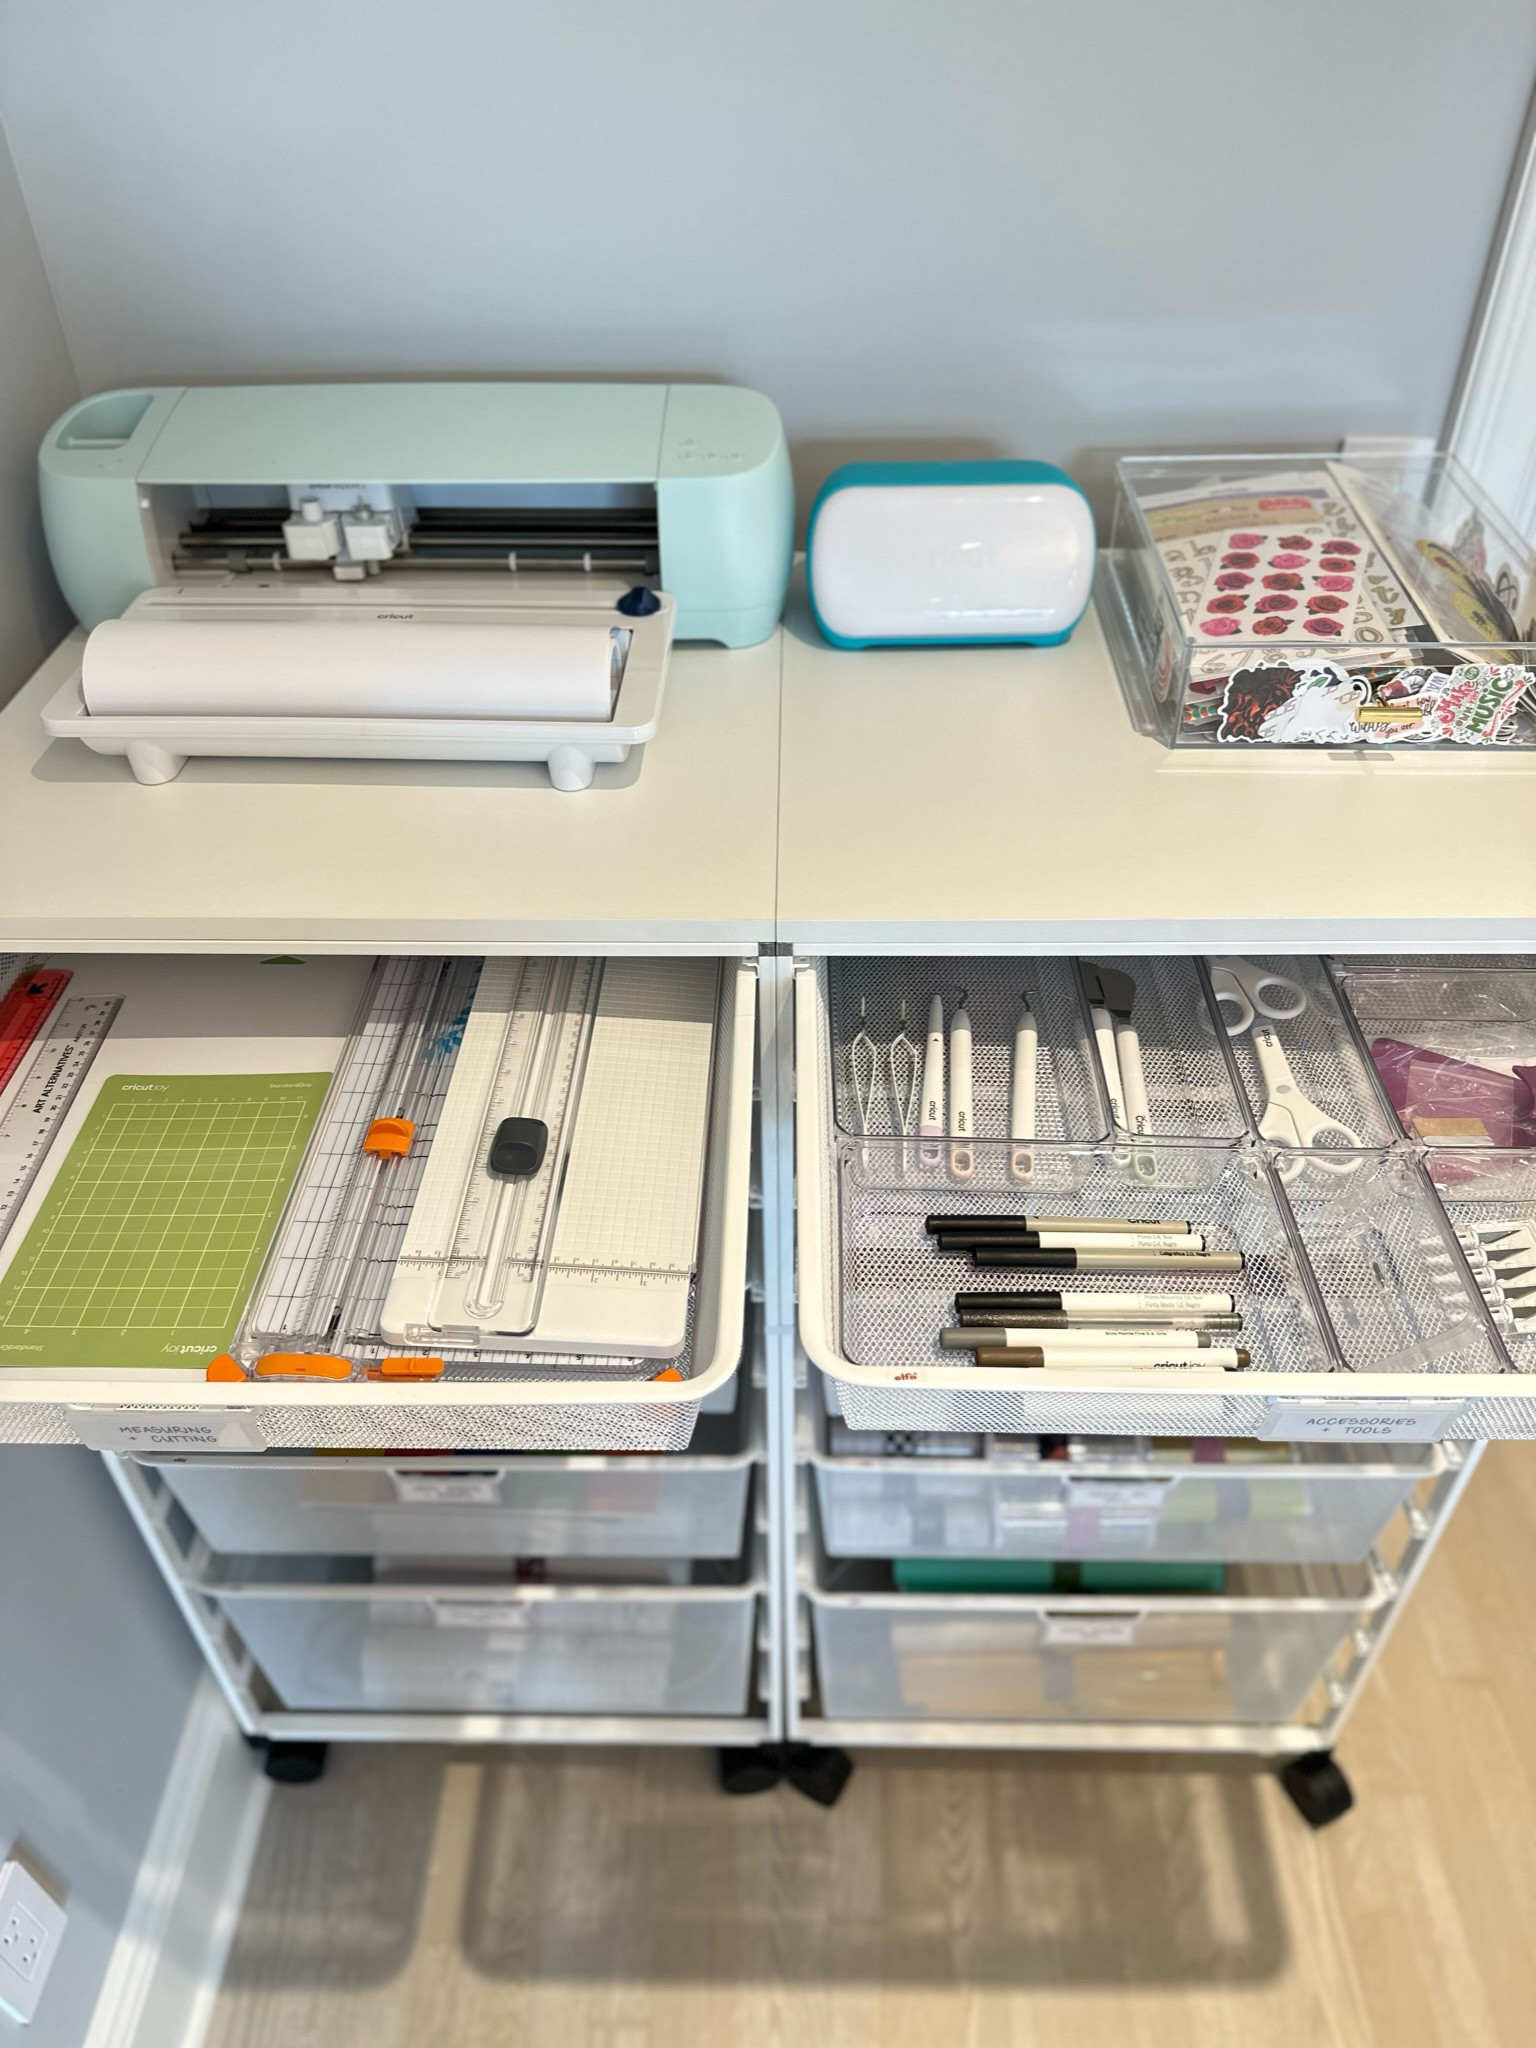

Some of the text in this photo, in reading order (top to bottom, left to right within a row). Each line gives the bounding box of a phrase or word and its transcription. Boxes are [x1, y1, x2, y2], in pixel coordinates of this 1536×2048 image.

[1465, 676, 1514, 734] MUSIC
[1260, 1029, 1273, 1048] cricut
[33, 1099, 47, 1114] ART
[41, 1044, 75, 1098] ALTERNATIVES
[121, 1083, 153, 1091] cricut
[928, 1100, 938, 1121] cricut
[958, 1111, 968, 1132] cricut
[180, 1345, 218, 1355] cricut
[1305, 1417, 1417, 1426] ACCESSORIES
[119, 1426, 213, 1434] MEASURING
[1344, 1426, 1393, 1434] TOOLS
[151, 1435, 218, 1443] CUTTING
